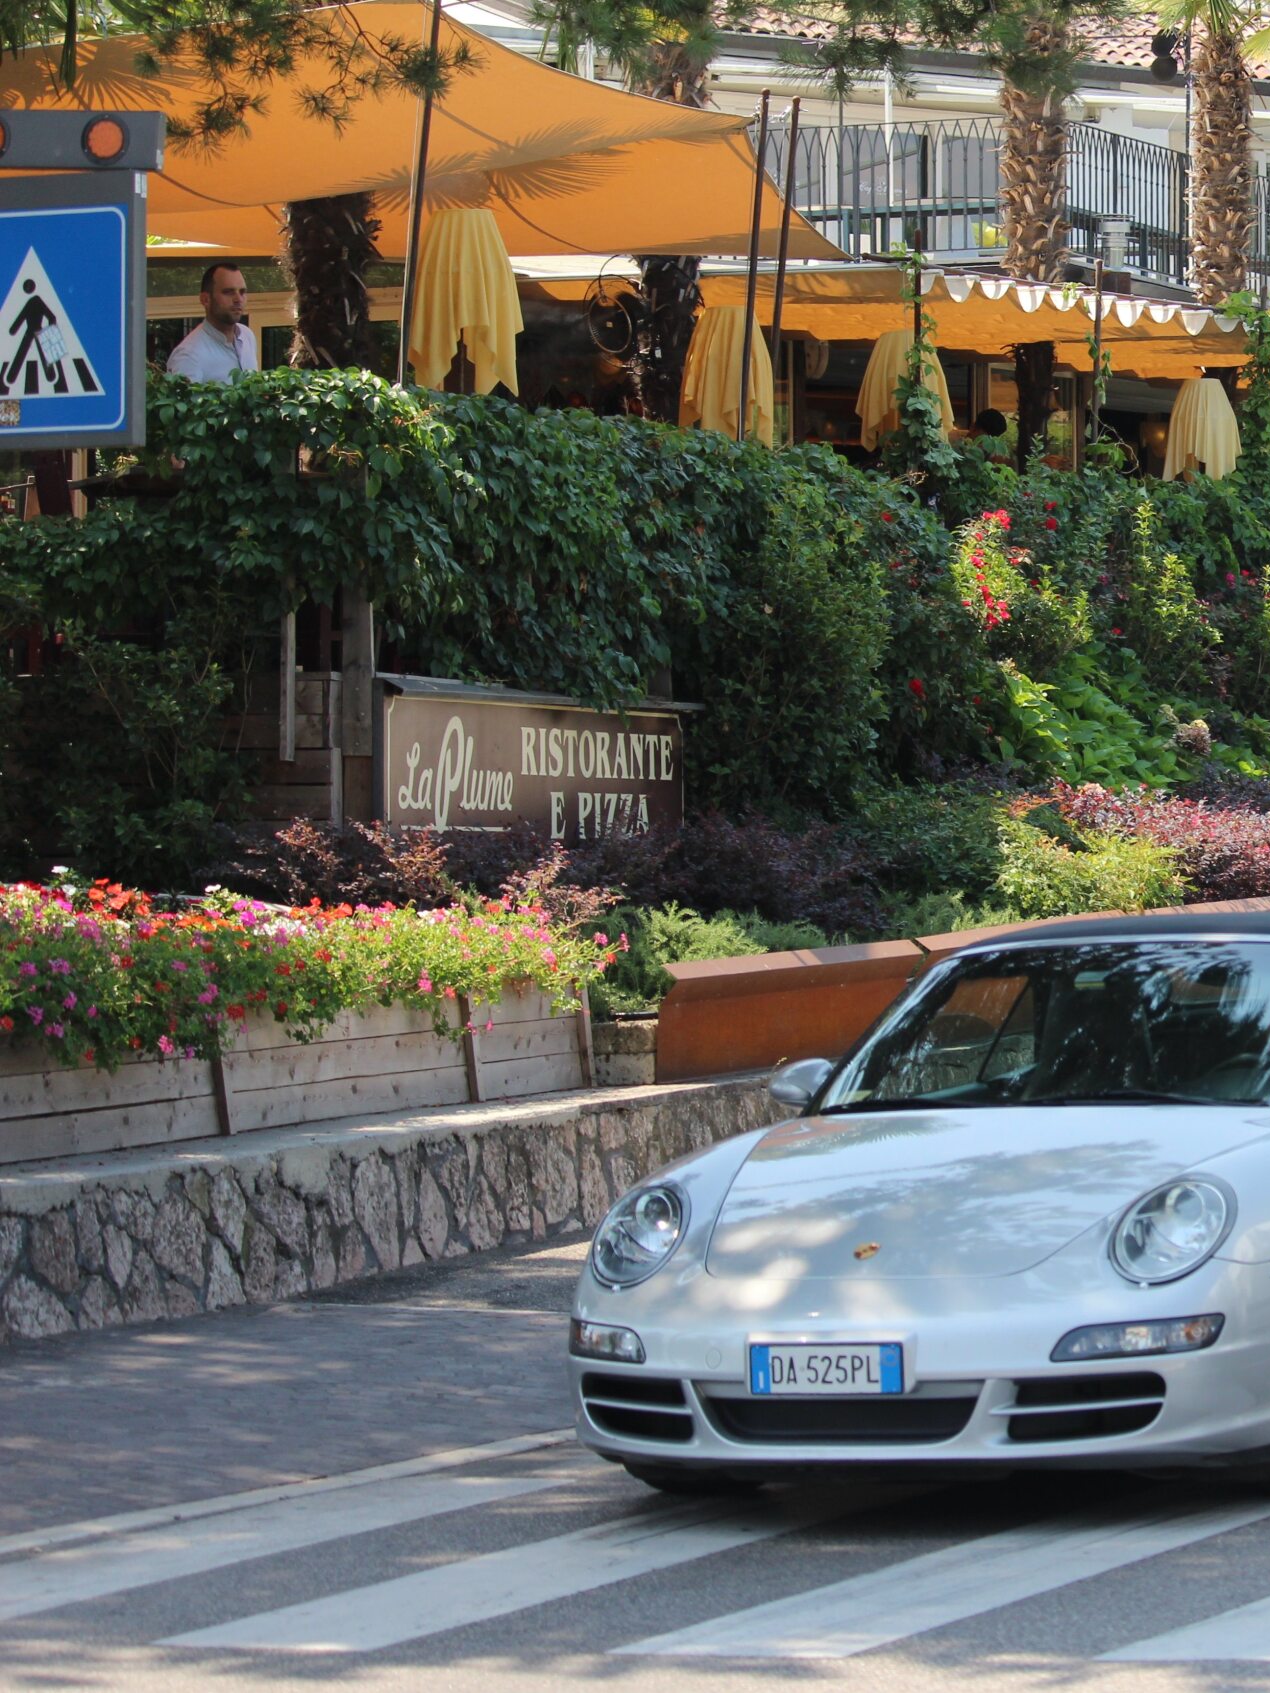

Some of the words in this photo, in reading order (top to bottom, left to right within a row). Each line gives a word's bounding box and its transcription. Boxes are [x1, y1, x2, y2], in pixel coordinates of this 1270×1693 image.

[398, 742, 433, 810] La
[436, 715, 513, 834] Plume
[520, 726, 674, 781] RISTORANTE
[550, 791, 566, 839] E
[578, 792, 650, 840] PIZZA
[771, 1356, 797, 1384] DA
[807, 1355, 879, 1384] 525PL
